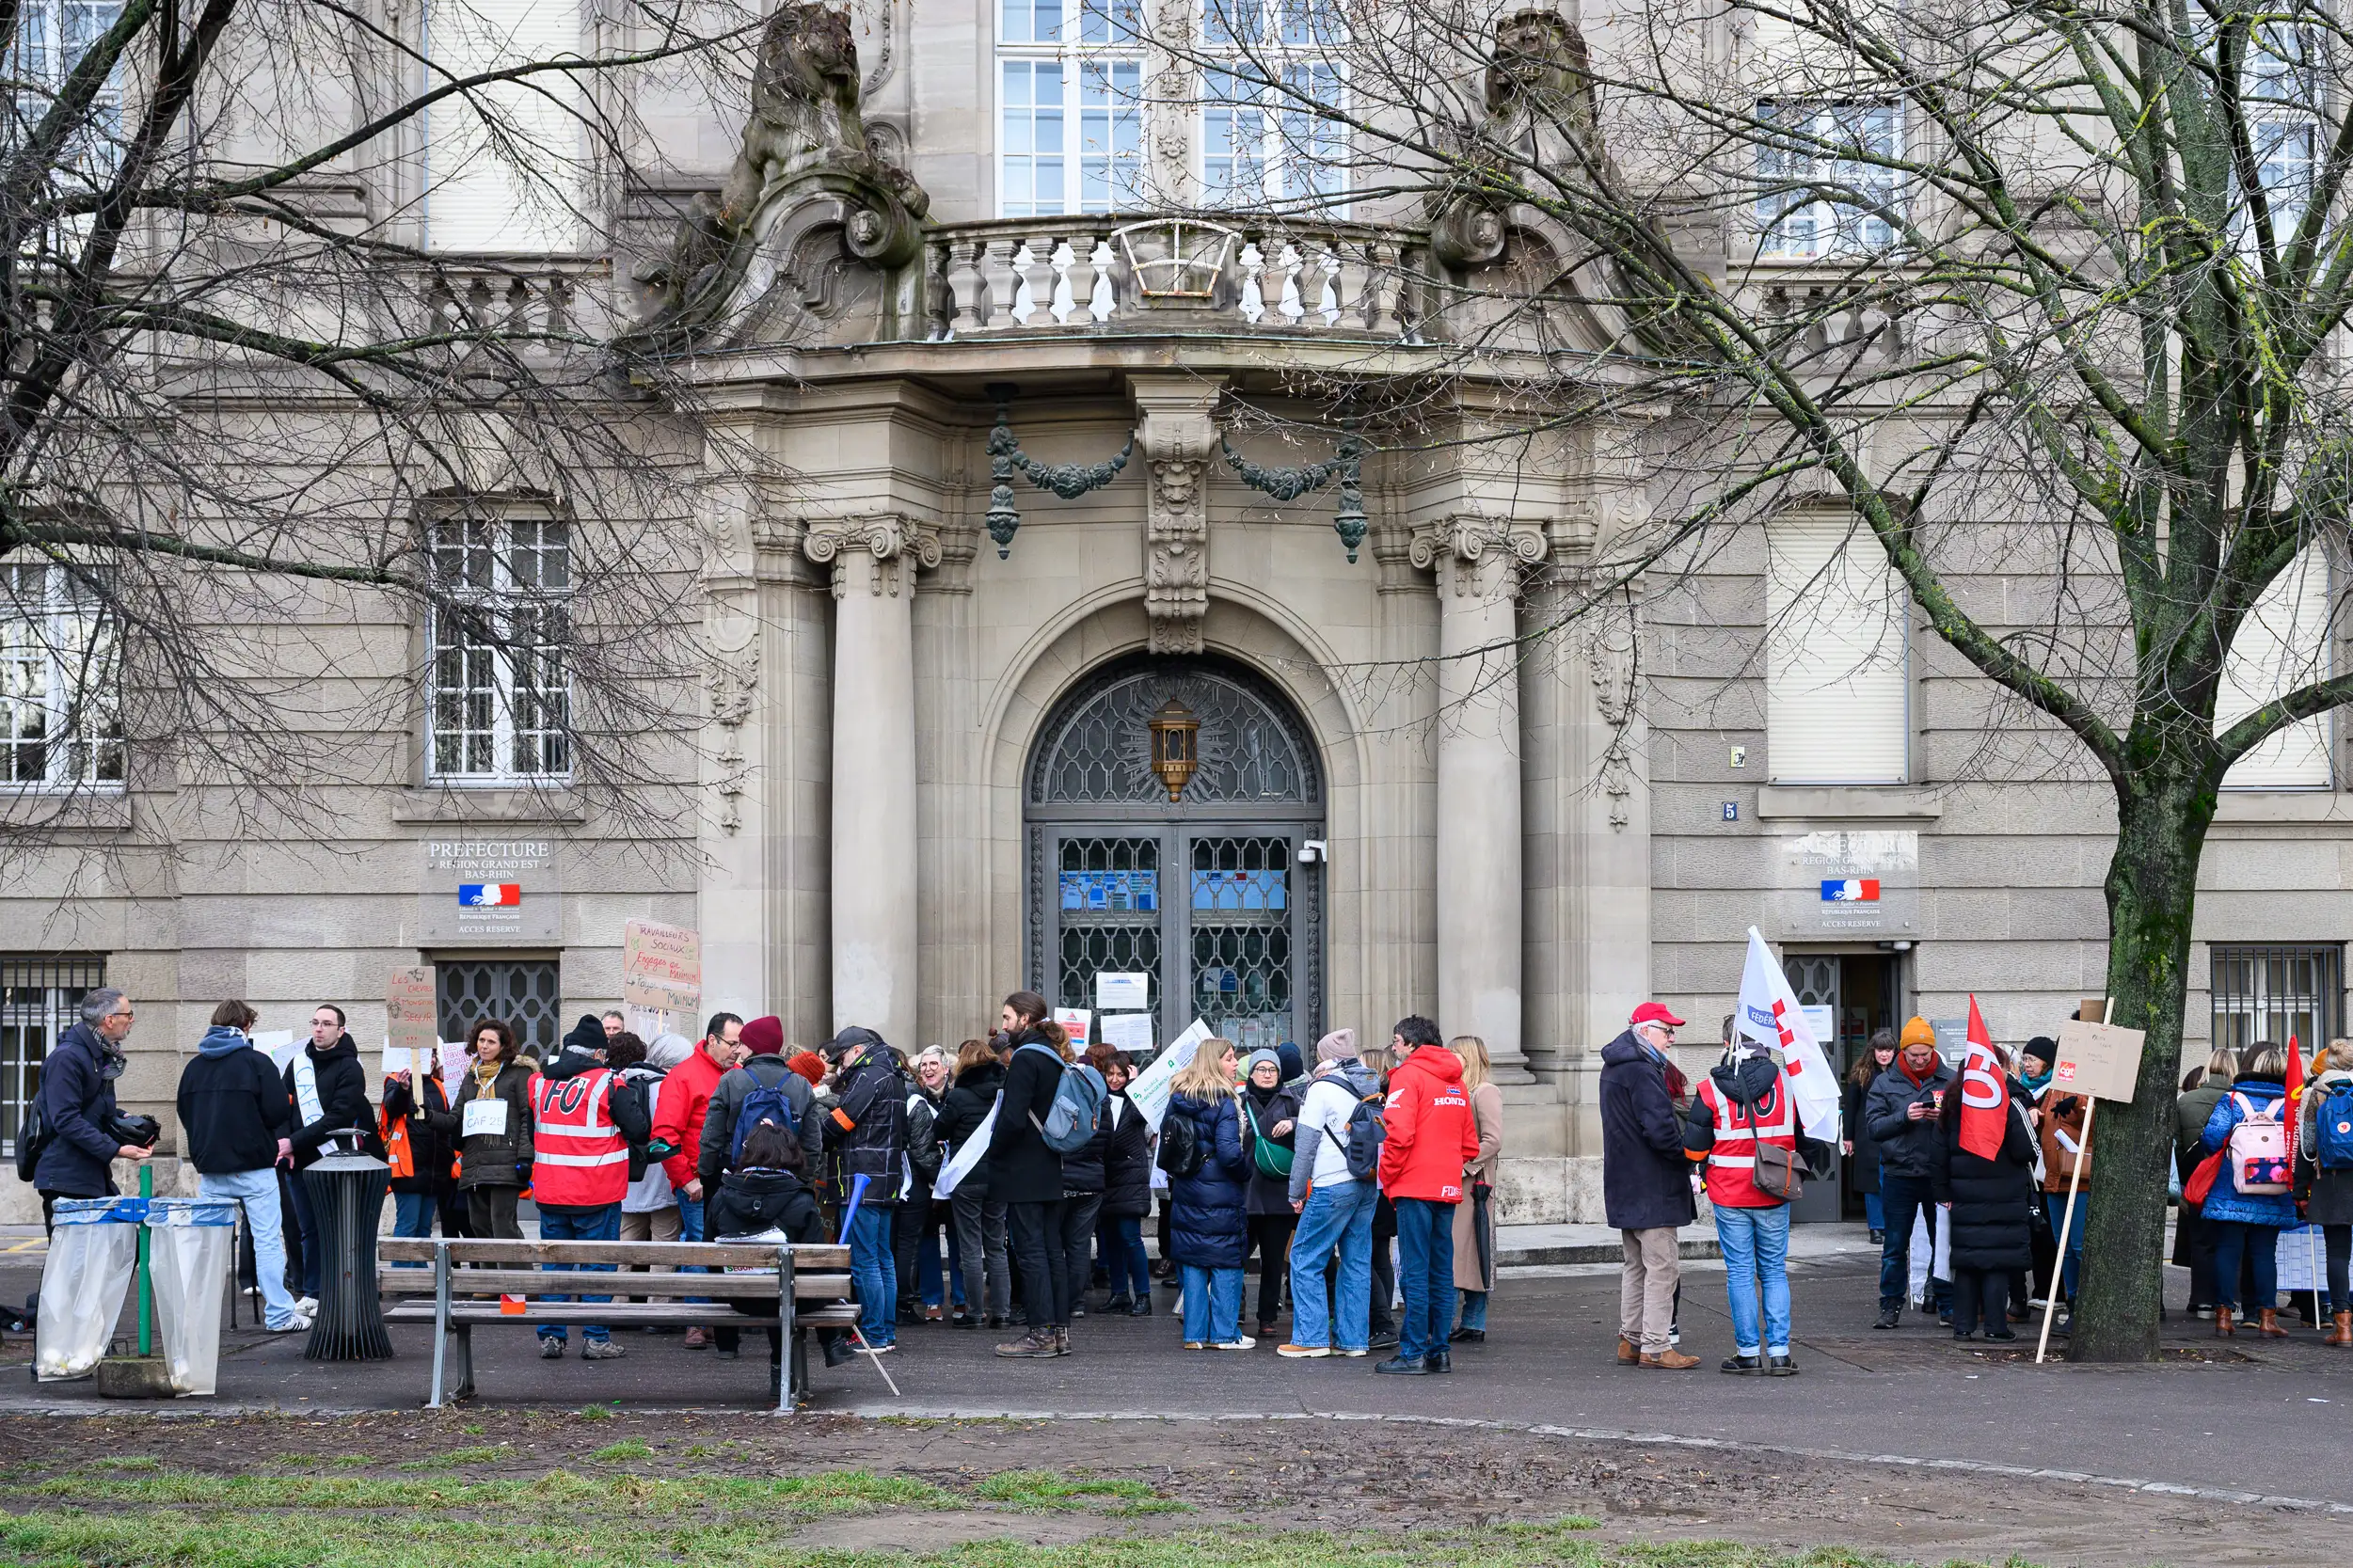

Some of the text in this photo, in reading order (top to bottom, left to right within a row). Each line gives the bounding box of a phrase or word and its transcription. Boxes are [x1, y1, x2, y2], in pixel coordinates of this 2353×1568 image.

[1725, 803, 1735, 818] 5
[430, 842, 549, 857] PREFECTURE
[439, 860, 540, 869] REGION GRAND EST
[1803, 857, 1899, 865] REGION GRAND EST
[465, 870, 515, 879] BAS-RHIN
[638, 924, 690, 942] TRAVAILLEURS
[651, 940, 685, 954] SOCIAUX
[404, 1010, 434, 1024] SEGUR
[443, 1043, 457, 1053] Les
[444, 1049, 465, 1060] trava
[445, 1054, 471, 1068] sociau
[444, 1070, 461, 1081] sont
[1962, 1040, 2002, 1110] FO
[2059, 1067, 2075, 1077] cgt
[543, 1076, 590, 1115] FO
[467, 1116, 504, 1128] CAF 25
